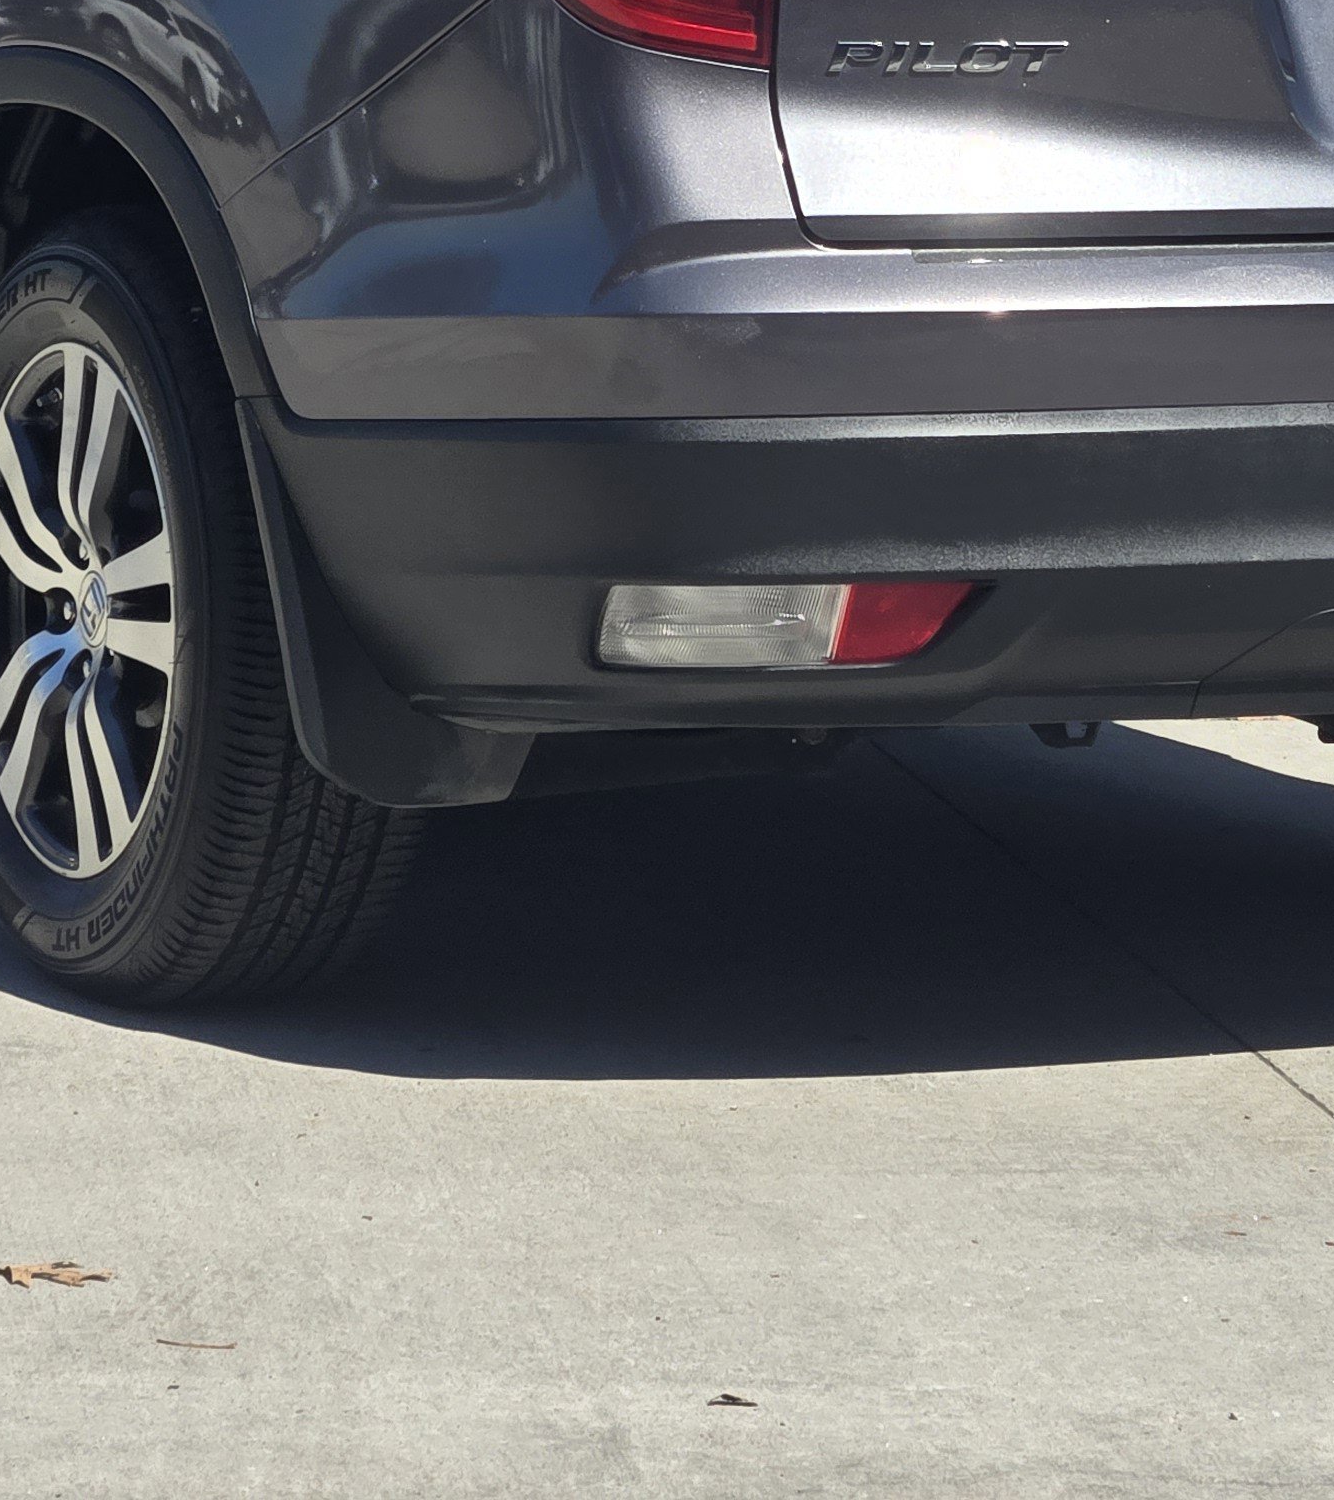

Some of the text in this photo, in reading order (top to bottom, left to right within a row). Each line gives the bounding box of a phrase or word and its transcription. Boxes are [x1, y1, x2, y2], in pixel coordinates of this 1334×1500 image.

[825, 40, 1070, 75] PILOT
[24, 268, 53, 297] HT
[51, 721, 184, 952] PATHFINDER HT
